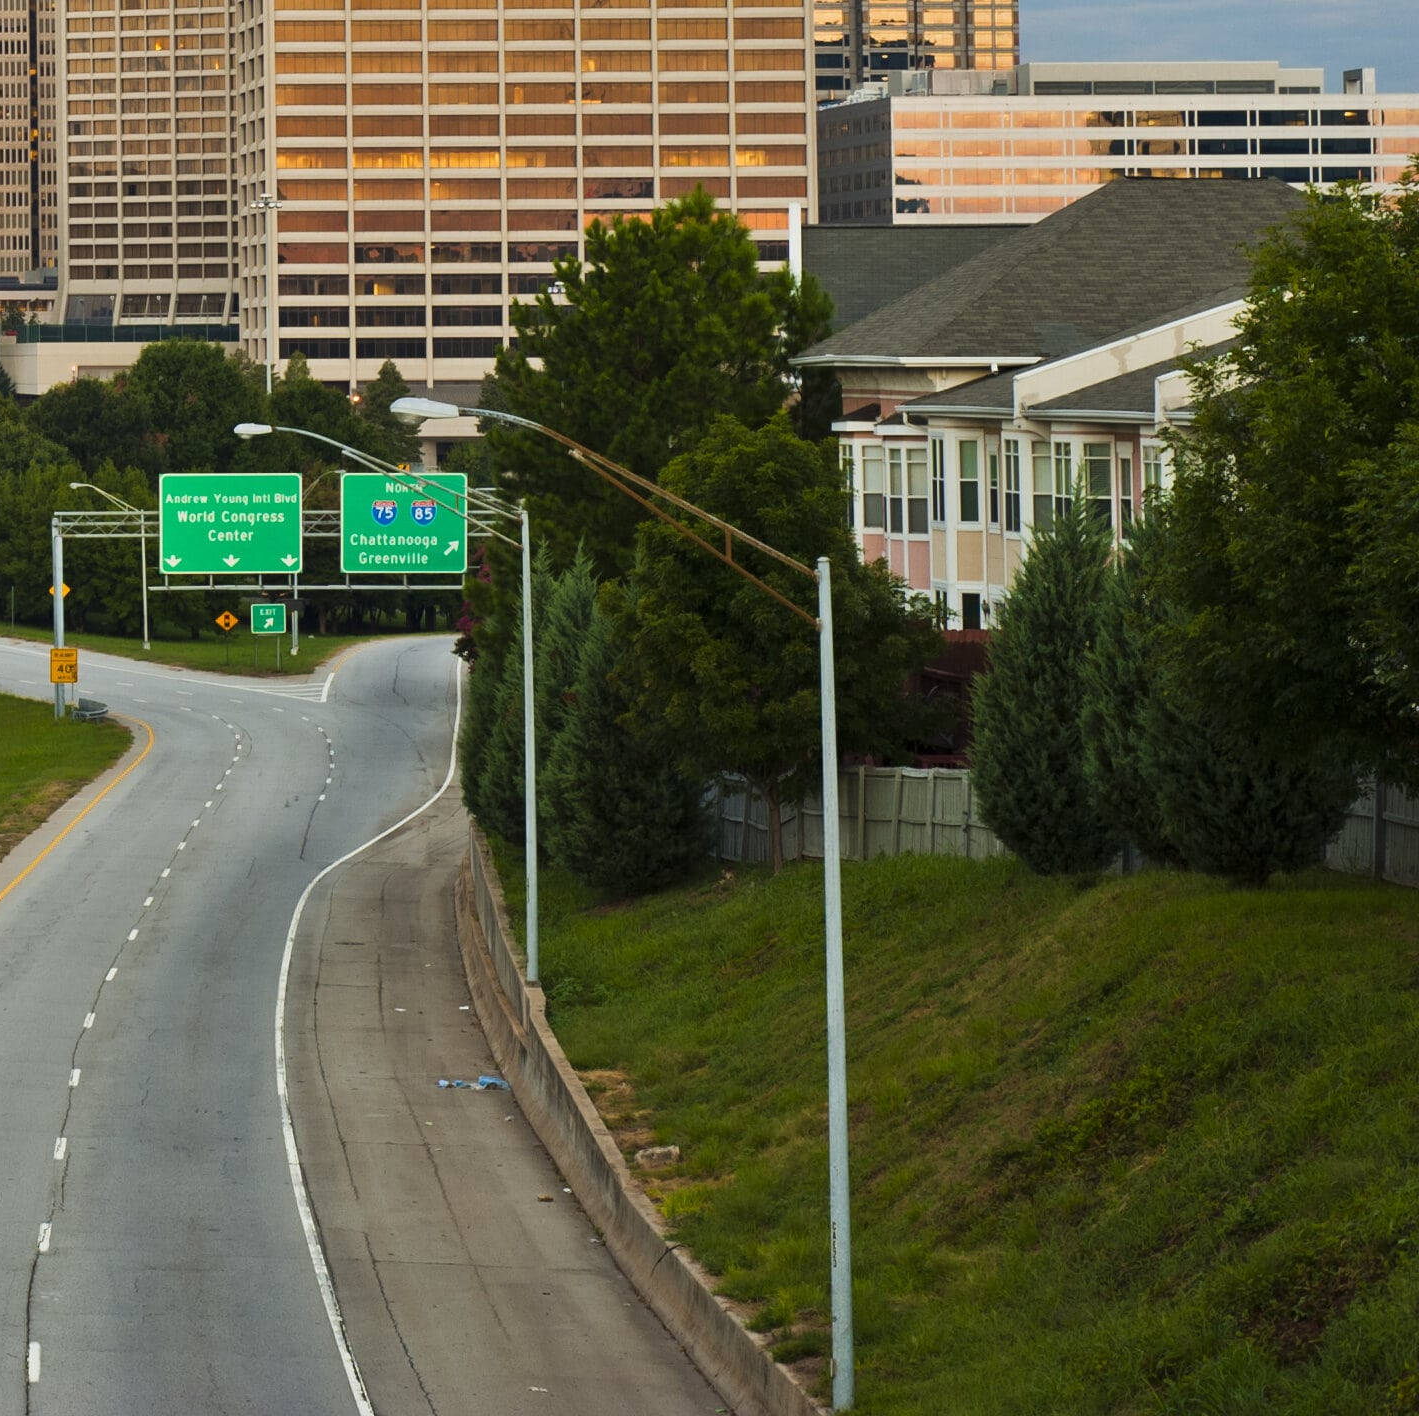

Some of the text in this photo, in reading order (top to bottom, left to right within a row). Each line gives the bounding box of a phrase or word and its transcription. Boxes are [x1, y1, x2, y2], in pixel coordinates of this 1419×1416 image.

[165, 493, 297, 505] Andrew Young Intl Blvd
[177, 510, 285, 525] World Congress
[375, 507, 394, 519] 75
[415, 507, 433, 520] 85
[208, 529, 254, 542] Center
[350, 533, 438, 549] Chattanooga
[359, 552, 428, 565] Greenville
